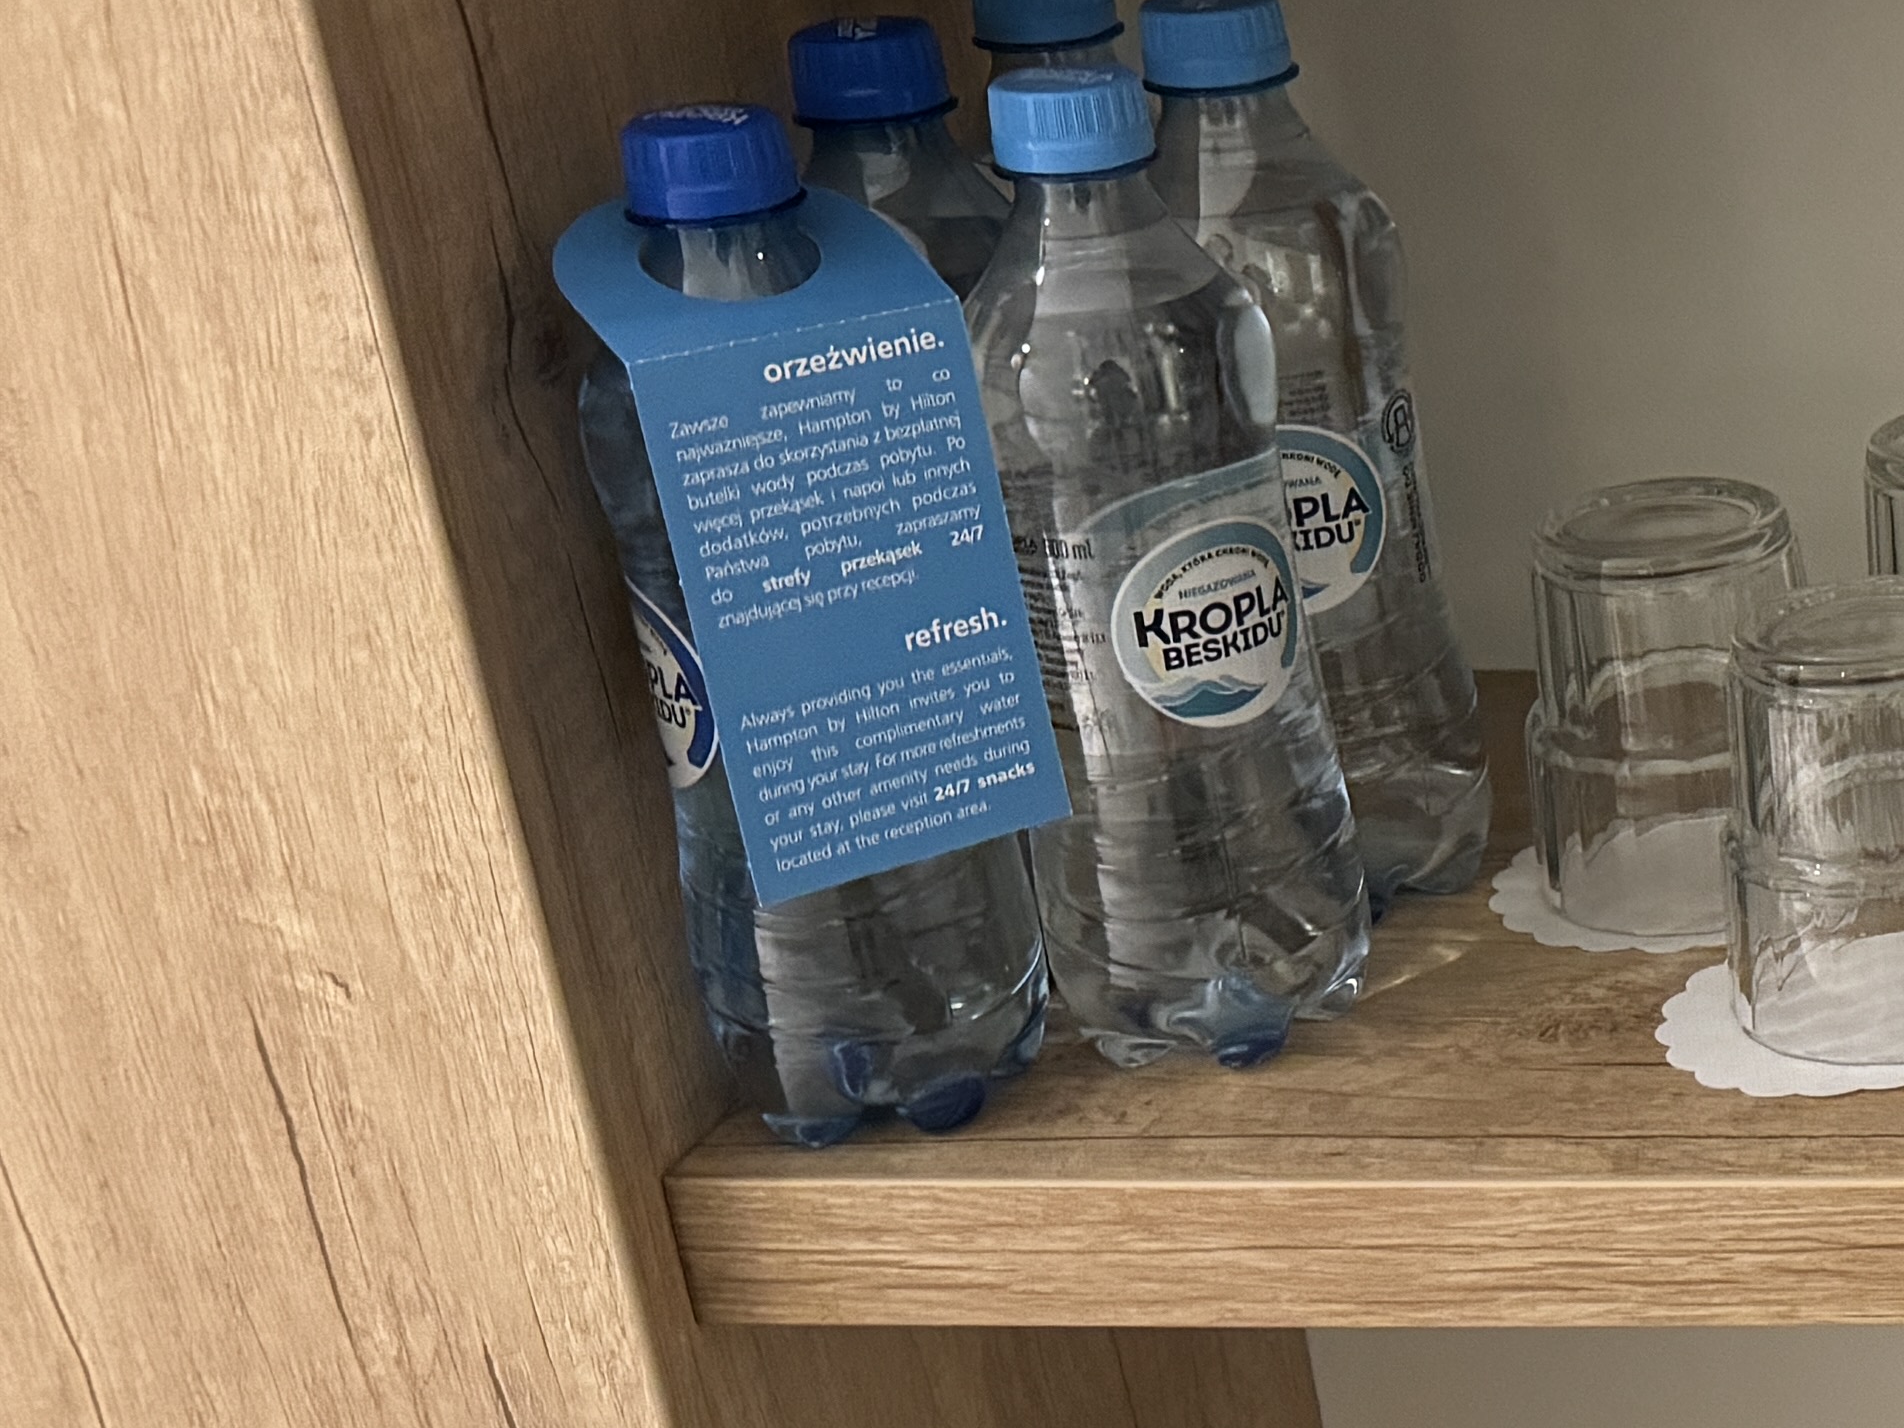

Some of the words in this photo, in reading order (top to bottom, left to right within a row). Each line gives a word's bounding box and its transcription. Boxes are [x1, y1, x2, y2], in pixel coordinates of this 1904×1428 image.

[759, 387, 855, 420] zapewniamy
[885, 378, 902, 392] to
[931, 368, 950, 382] co
[798, 408, 871, 436] Hampton
[880, 401, 900, 420] by
[909, 391, 955, 411] Hilton
[682, 460, 750, 487] zaprasza
[753, 453, 774, 471] do
[778, 434, 868, 465] skorzystania
[872, 430, 881, 444] z
[686, 483, 740, 510] butelki
[750, 473, 794, 496] wody
[805, 458, 869, 487] podczas
[946, 434, 965, 451] Po
[891, 469, 916, 487] lub
[923, 456, 970, 480] innych
[800, 497, 900, 537] potrzebnych
[911, 481, 976, 511] podczas
[895, 503, 980, 535] zapraszamy
[1292, 486, 1370, 528] PLA
[710, 587, 733, 605] do
[761, 566, 810, 593] strefy
[949, 523, 983, 546] 24/7
[826, 582, 858, 604] przy
[904, 606, 1007, 652] refresh.
[1133, 575, 1290, 648] KROPLA
[740, 704, 795, 731] Always
[800, 684, 871, 717] providing
[876, 676, 904, 697] you
[910, 667, 934, 684] the
[745, 724, 818, 755] Hampton
[826, 717, 845, 732] by
[855, 702, 899, 724] Hilton
[908, 687, 955, 710] invites
[963, 677, 990, 698] you
[998, 671, 1014, 684] to
[752, 756, 793, 778] enjoy
[810, 744, 838, 762] this
[854, 709, 963, 749] complimentary
[979, 693, 1019, 715] water
[758, 778, 805, 802] during
[806, 768, 837, 791] your
[875, 751, 897, 769] For
[899, 741, 936, 762] more
[939, 716, 1025, 750] refreshments
[764, 810, 779, 826] or
[788, 801, 814, 819] any
[821, 787, 861, 809] other
[869, 768, 927, 796] amenity
[934, 753, 978, 776] needs
[983, 739, 1030, 762] during
[769, 829, 802, 853] your
[848, 802, 895, 829] please
[900, 791, 928, 811] visit
[933, 777, 970, 801] 24/7
[977, 761, 1035, 789] snacks
[775, 842, 832, 872] located
[835, 839, 851, 856] at
[854, 832, 879, 850] the
[884, 810, 952, 840] reception
[956, 800, 991, 819] area.
